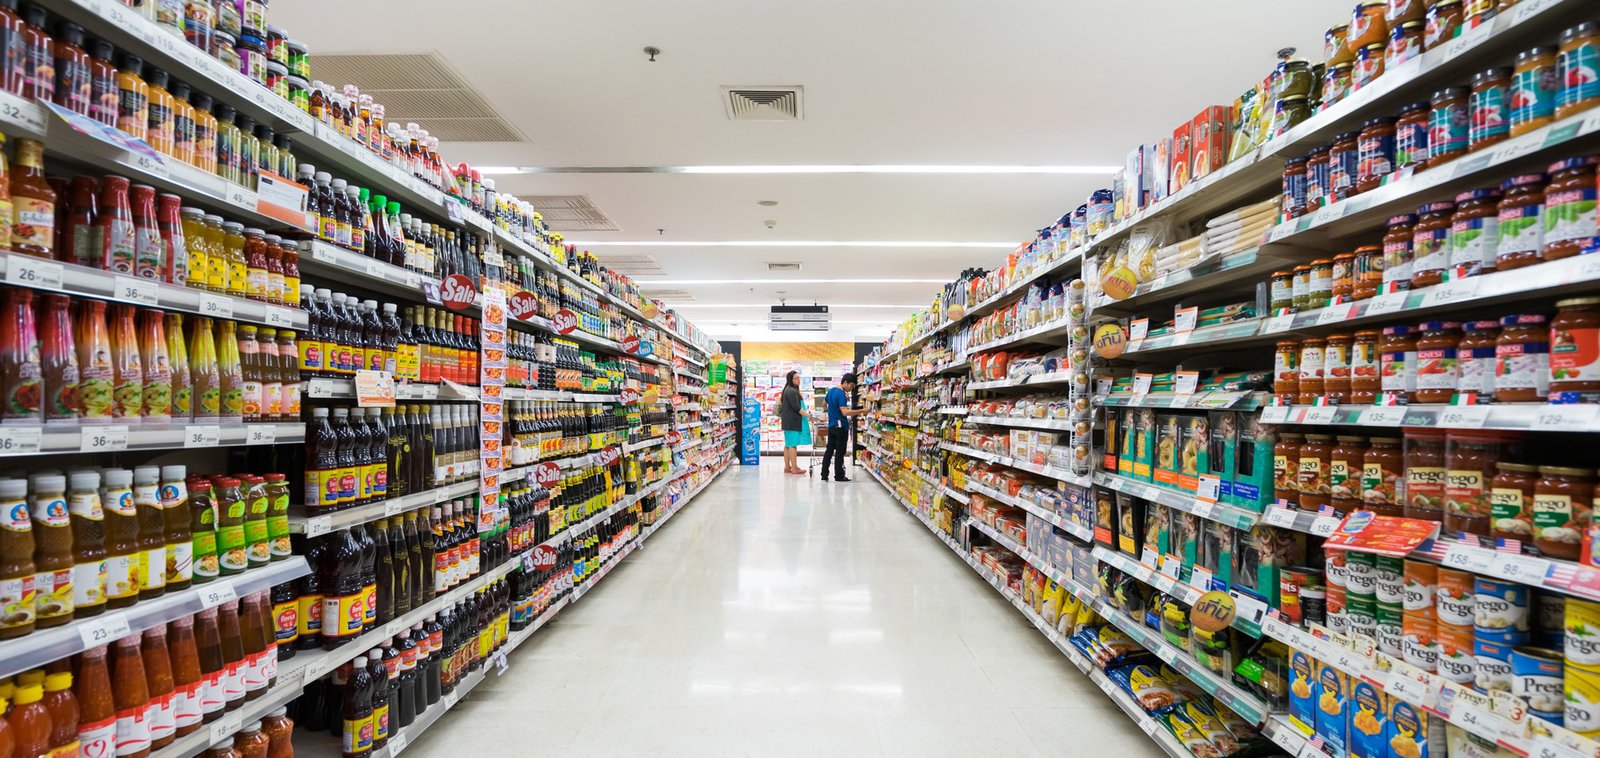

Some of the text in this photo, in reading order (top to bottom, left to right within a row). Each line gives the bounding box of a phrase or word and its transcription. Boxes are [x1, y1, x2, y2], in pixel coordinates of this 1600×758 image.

[2, 103, 20, 119] 32
[137, 156, 150, 169] 45
[233, 193, 243, 203] 49
[19, 268, 35, 281] 26
[125, 287, 138, 299] 36
[441, 277, 474, 303] Sale
[1434, 289, 1453, 300] 135
[206, 302, 217, 311] 30
[511, 295, 538, 317] Sale
[271, 313, 280, 322] 28
[555, 312, 577, 331] Sale
[314, 386, 322, 394] 24
[620, 390, 639, 404] Sale
[1369, 413, 1385, 422] 135
[1539, 414, 1562, 425] 129
[92, 436, 106, 447] 36
[192, 433, 203, 443] 36
[253, 432, 262, 441] 36
[601, 448, 618, 464] Sale
[537, 465, 560, 482] Sale
[313, 524, 321, 533] 27
[1318, 524, 1330, 534] 158
[533, 547, 556, 566] Sale
[1450, 553, 1469, 565] 158
[1327, 563, 1345, 577] Pre
[1503, 563, 1519, 576] 98
[1280, 581, 1297, 592] nt's
[208, 593, 219, 603] 59
[1477, 600, 1509, 613] rego
[92, 629, 107, 640] 23
[1377, 628, 1402, 651] Preg
[1351, 639, 1356, 650] 1
[1366, 646, 1374, 657] 3
[1338, 657, 1349, 667] 54
[1439, 657, 1472, 675] rego
[1478, 662, 1512, 676] rego
[1393, 683, 1405, 693] 54
[1524, 677, 1564, 695] Preg
[1458, 688, 1486, 705] Prego
[1489, 698, 1494, 710] 1
[1464, 712, 1476, 724] 54
[1511, 706, 1523, 721] 3
[217, 725, 226, 737] 18
[1279, 734, 1288, 745] 75
